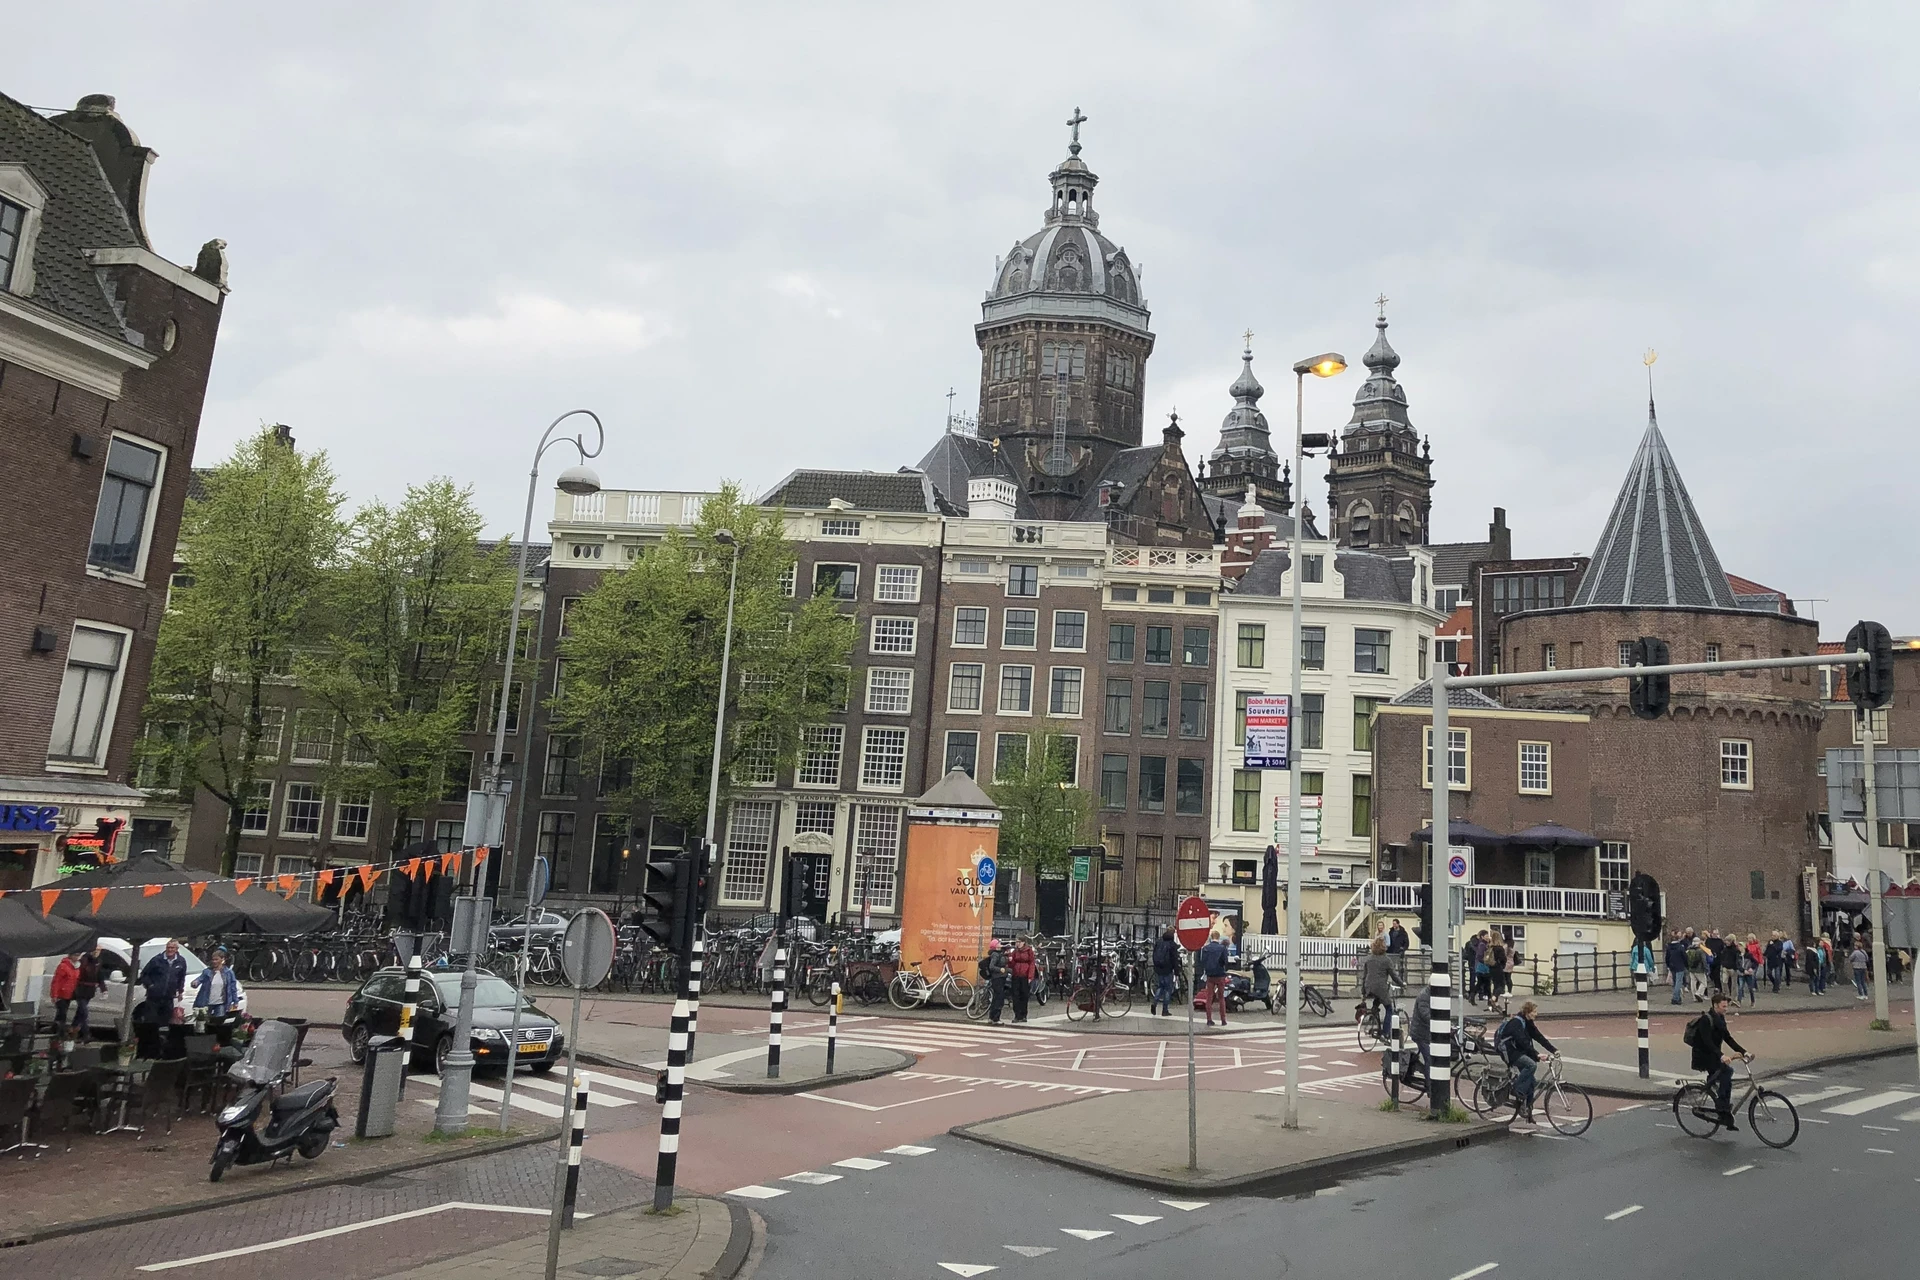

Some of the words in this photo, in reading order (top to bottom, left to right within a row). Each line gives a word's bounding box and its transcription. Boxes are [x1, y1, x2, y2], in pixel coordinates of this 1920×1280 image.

[1248, 697, 1263, 705] Bobo
[1264, 697, 1287, 705] Market
[1248, 707, 1286, 715] Souvenirs
[835, 866, 842, 876] 8
[956, 877, 981, 887] SOLD
[950, 887, 966, 895] VAN
